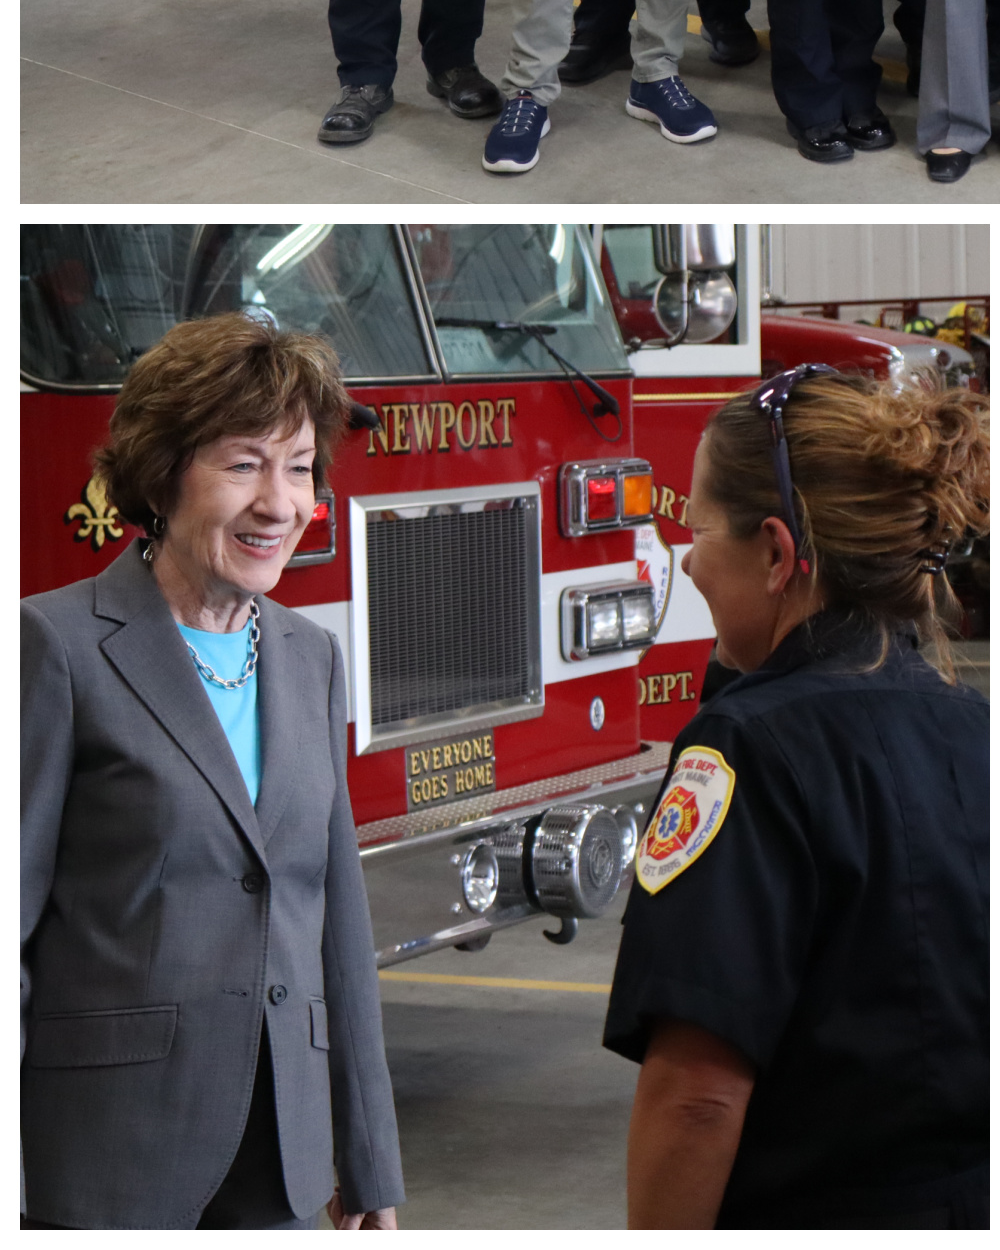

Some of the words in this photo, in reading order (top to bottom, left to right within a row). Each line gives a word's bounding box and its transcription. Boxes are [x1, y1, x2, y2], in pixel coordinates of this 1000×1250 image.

[366, 399, 516, 455] NEWPORT
[411, 734, 493, 776] EVERYONE
[696, 759, 718, 776] DEPT.
[412, 774, 449, 804] GOES
[454, 763, 494, 794] HOME
[686, 799, 722, 857] RESCUE
